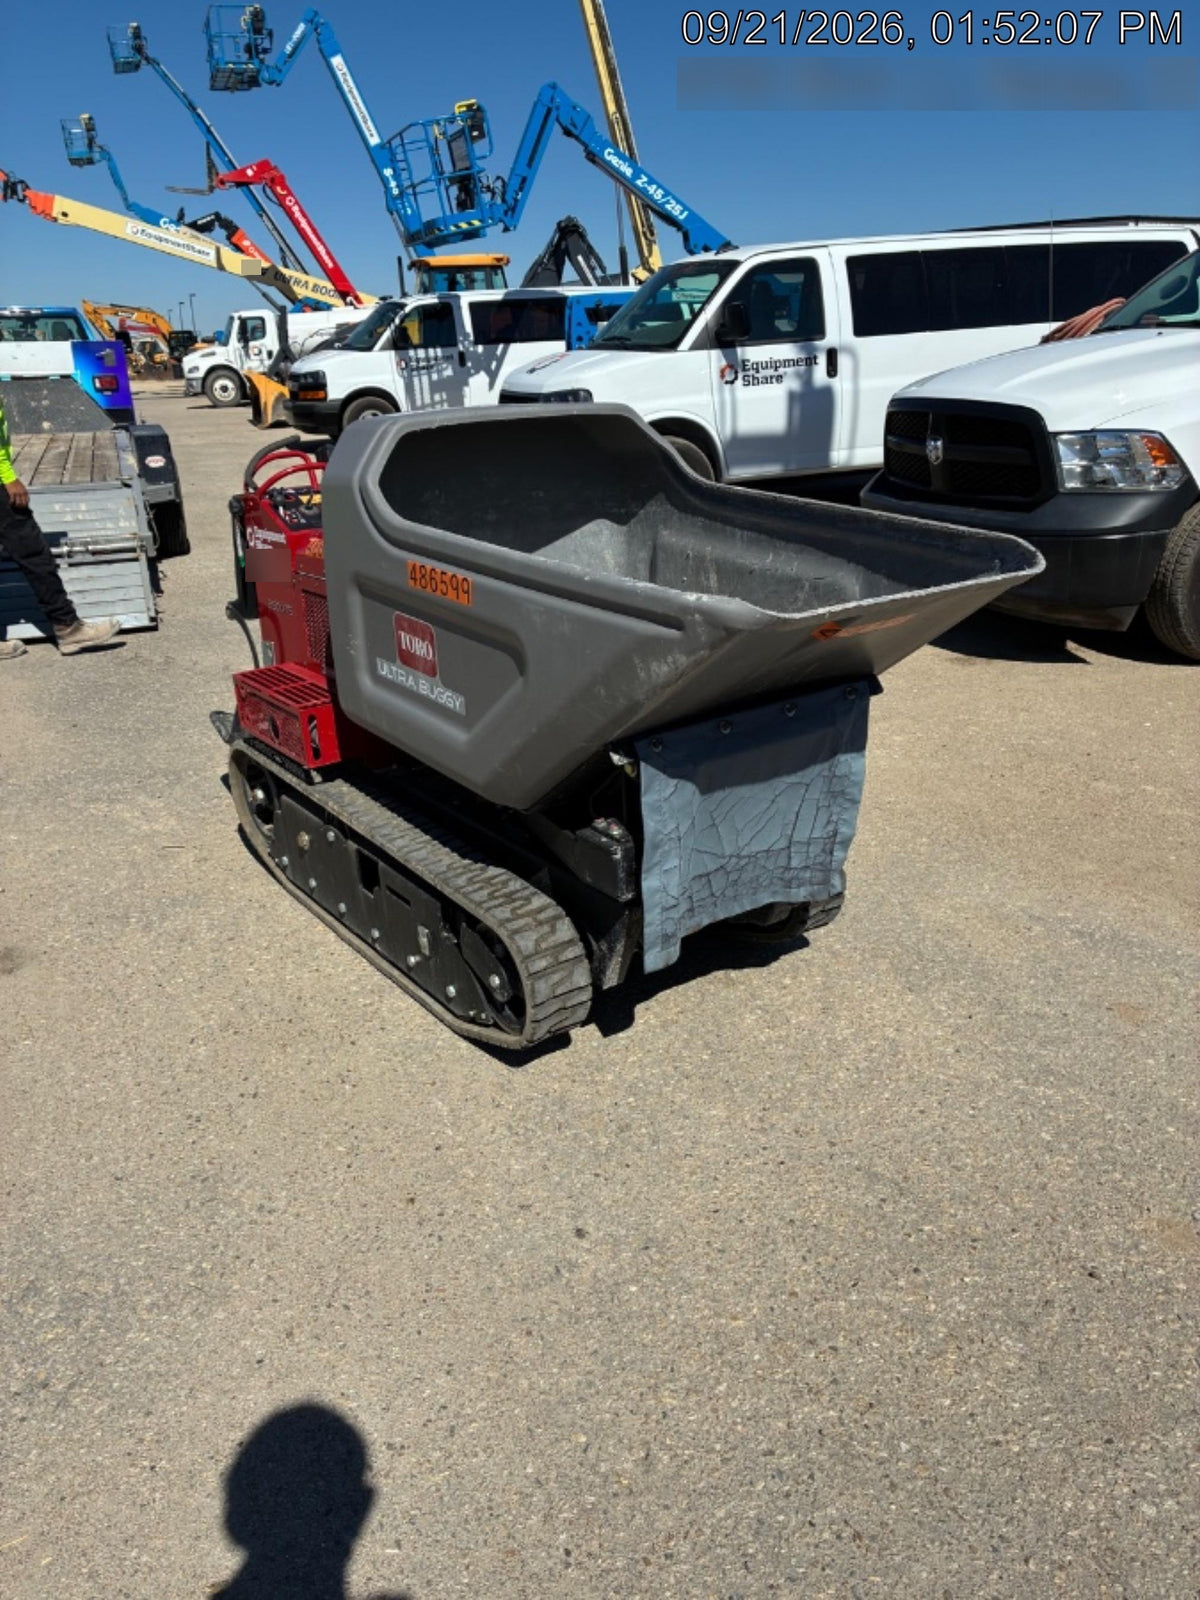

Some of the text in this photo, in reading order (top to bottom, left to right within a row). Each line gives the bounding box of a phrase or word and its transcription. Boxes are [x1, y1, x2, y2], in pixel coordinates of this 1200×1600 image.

[604, 147, 689, 220] Genie Z-45/25J
[742, 354, 819, 374] Equipment
[742, 373, 784, 387] Share
[409, 562, 471, 605] 486599
[398, 630, 433, 661] TORO
[376, 656, 463, 712] ULTRA BUGGY
